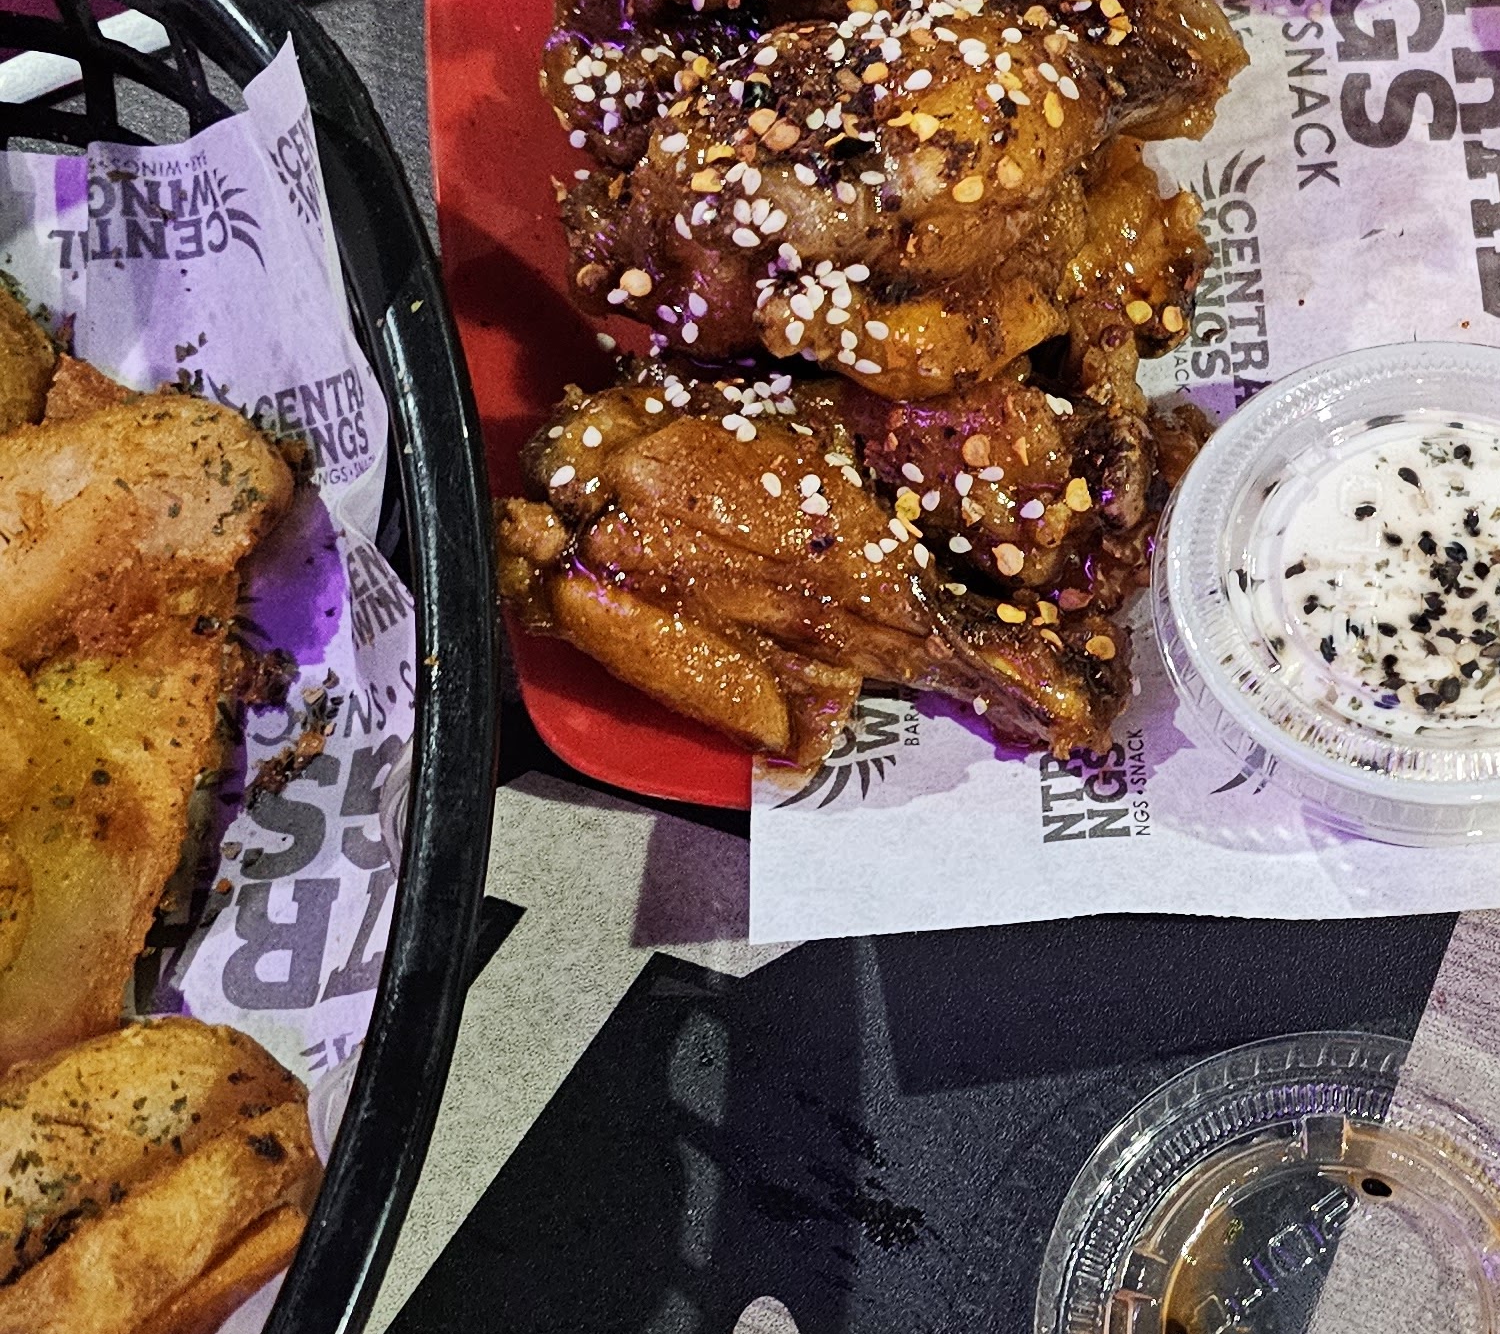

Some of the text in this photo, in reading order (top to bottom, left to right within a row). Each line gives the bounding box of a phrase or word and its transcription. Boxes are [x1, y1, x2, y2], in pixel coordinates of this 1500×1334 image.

[1282, 19, 1341, 192] SNACK
[1217, 198, 1273, 409] CENTRA
[904, 710, 921, 748] BAR
[1126, 727, 1148, 788] SNACK
